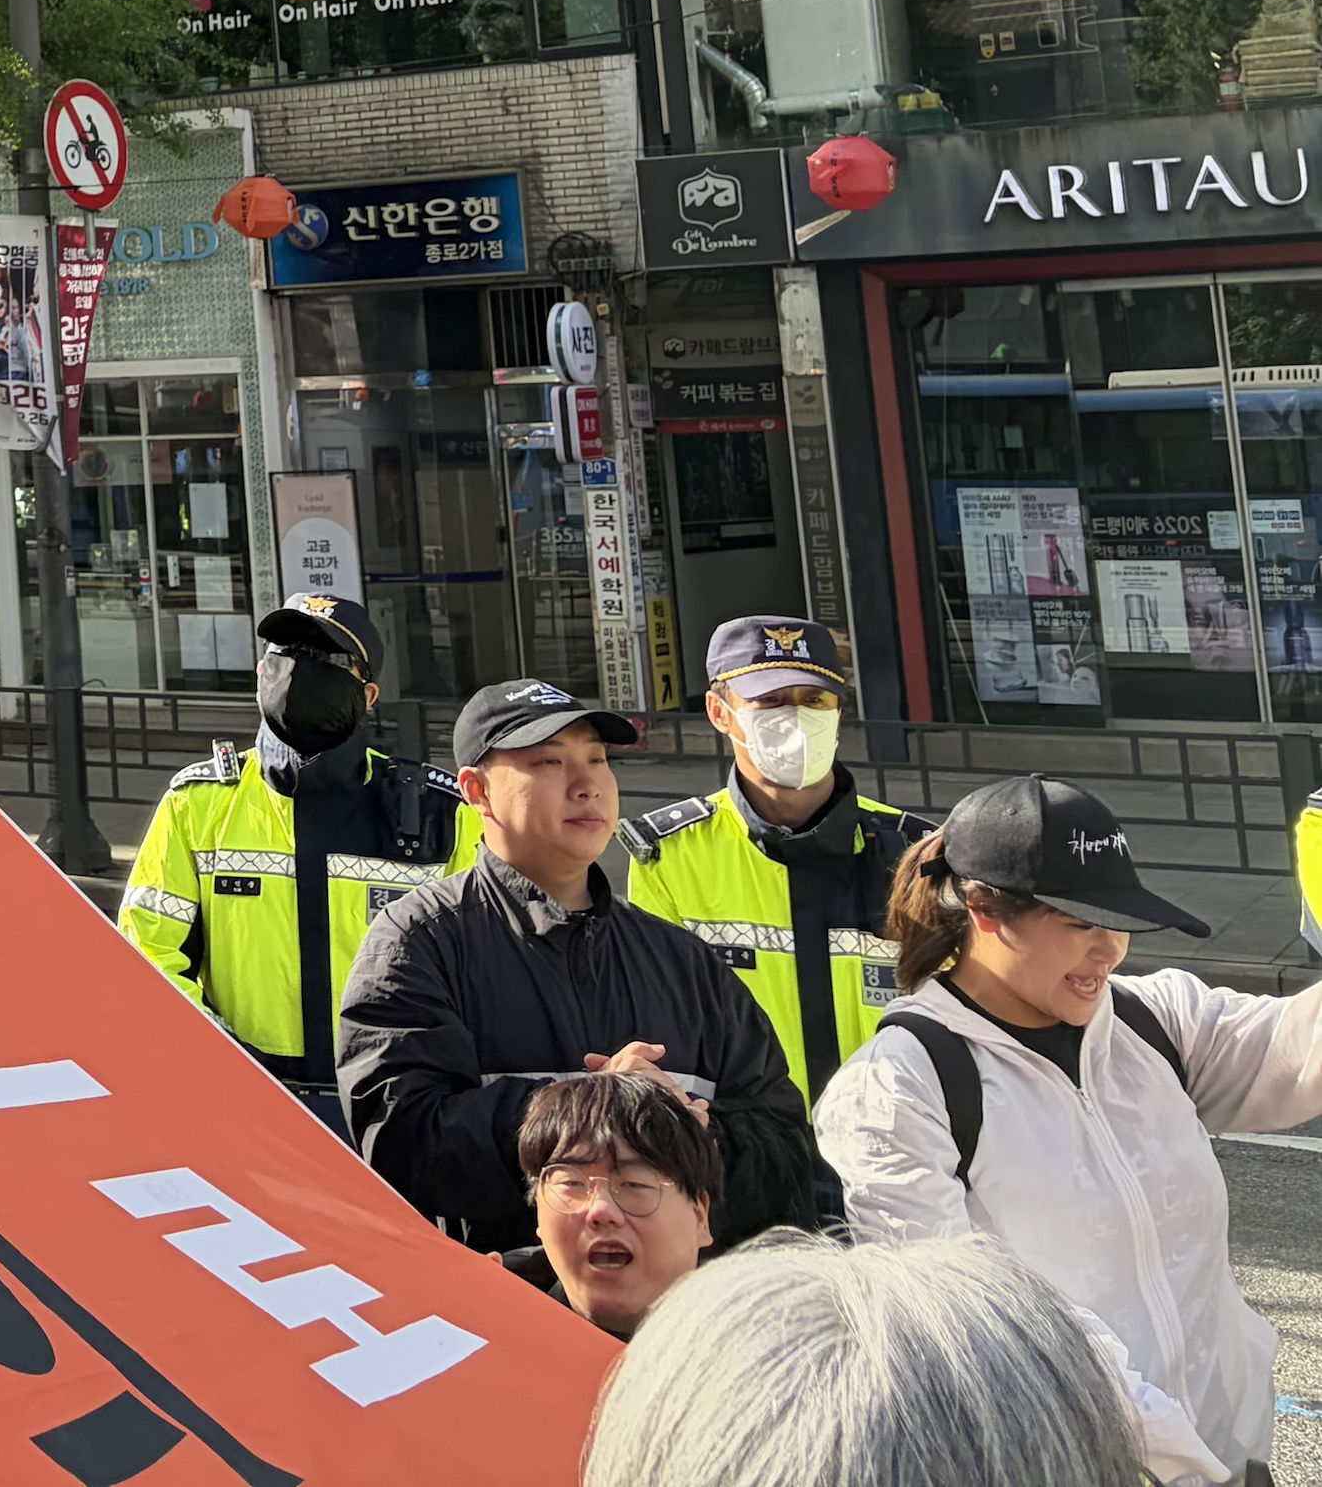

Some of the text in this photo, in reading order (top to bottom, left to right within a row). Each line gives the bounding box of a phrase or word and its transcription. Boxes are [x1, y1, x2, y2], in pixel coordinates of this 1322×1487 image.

[208, 11, 252, 32] Hair
[278, 3, 308, 24] On
[983, 147, 1310, 225] ARITAU
[341, 195, 502, 242] 신한은행
[424, 239, 505, 264] 종로2가점
[571, 326, 595, 354] 사진
[688, 336, 780, 357] 카페드람브
[679, 382, 715, 404] 커피
[758, 380, 777, 402] 집
[585, 462, 612, 474] 80-1
[306, 539, 331, 553] 고금
[592, 492, 625, 617] 한국서예학원
[806, 487, 840, 621] 카페드람브르
[302, 555, 339, 570] 최고가
[309, 572, 334, 587] 매입
